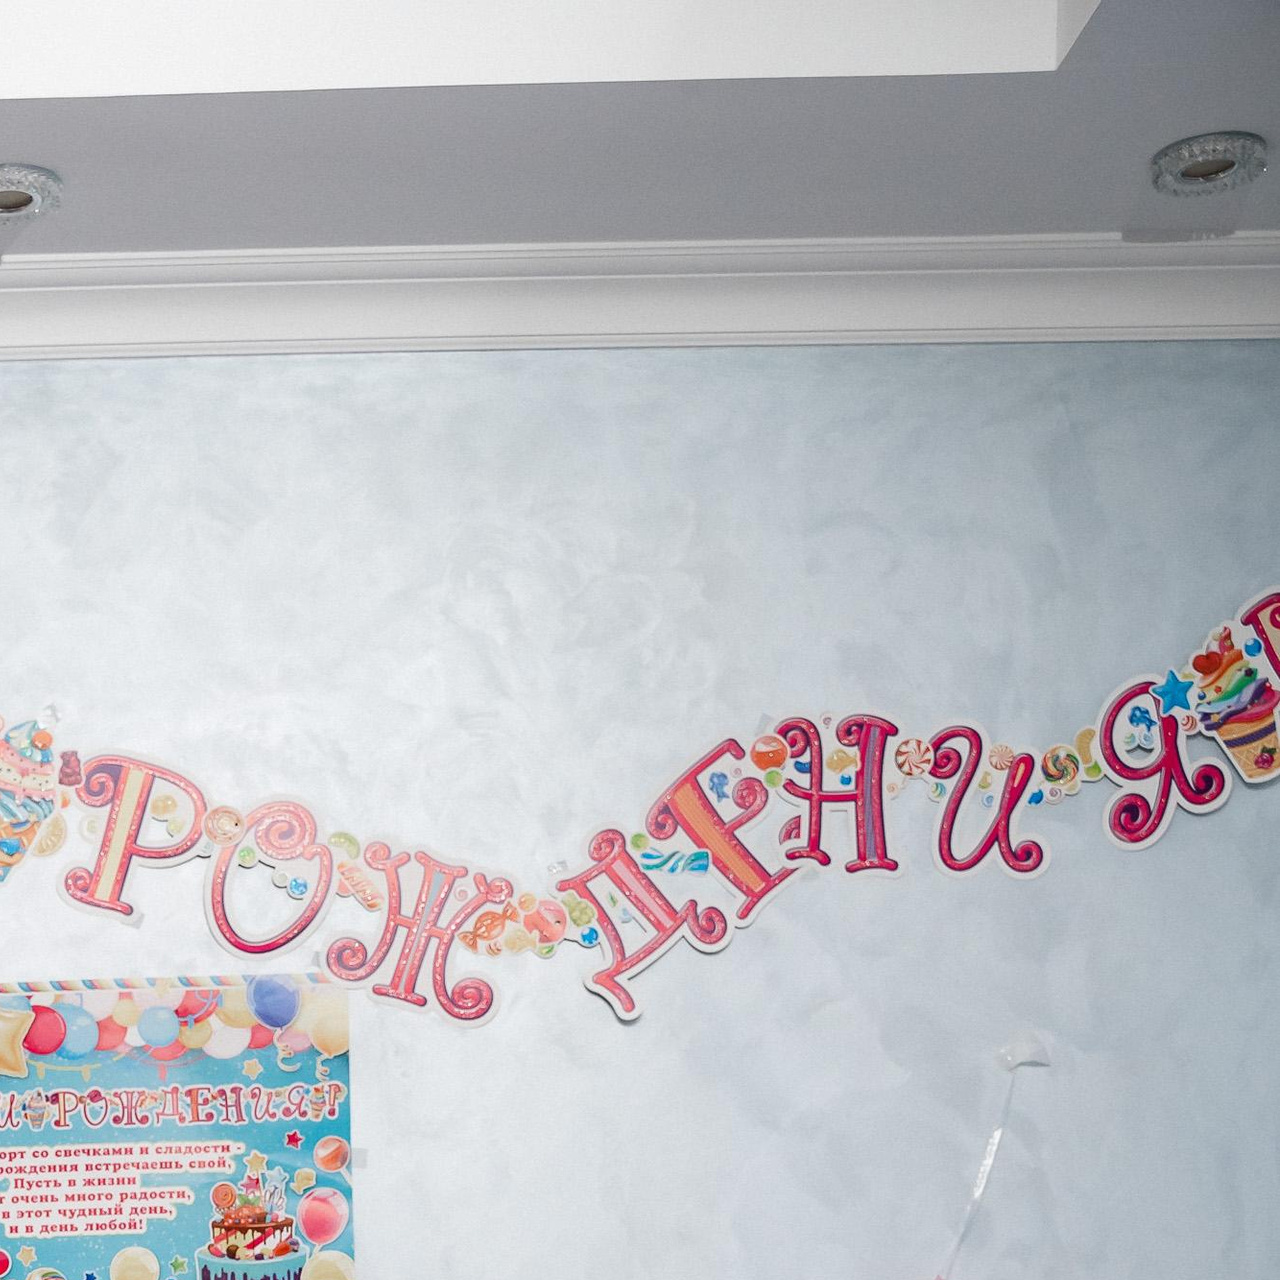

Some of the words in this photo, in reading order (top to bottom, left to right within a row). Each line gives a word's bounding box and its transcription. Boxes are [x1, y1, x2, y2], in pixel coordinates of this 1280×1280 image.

[32, 1149, 49, 1159] со
[55, 1146, 133, 1158] свечками
[140, 1145, 149, 1155] и
[155, 1143, 231, 1155] сладости
[85, 1160, 183, 1173] встречаешь
[189, 1156, 232, 1169] свой,
[13, 1178, 62, 1190] Пусть
[68, 1178, 77, 1187] в
[82, 1176, 137, 1187] жизни
[11, 1193, 59, 1203] очень
[64, 1191, 113, 1202] много
[119, 1189, 191, 1202] радости,
[2, 1210, 10, 1219] в
[16, 1208, 52, 1219] этот
[58, 1204, 123, 1219] чудный
[129, 1204, 173, 1217] день,
[9, 1224, 18, 1234] и
[25, 1224, 34, 1234] в
[39, 1222, 79, 1234] день
[84, 1219, 143, 1232] любой!
